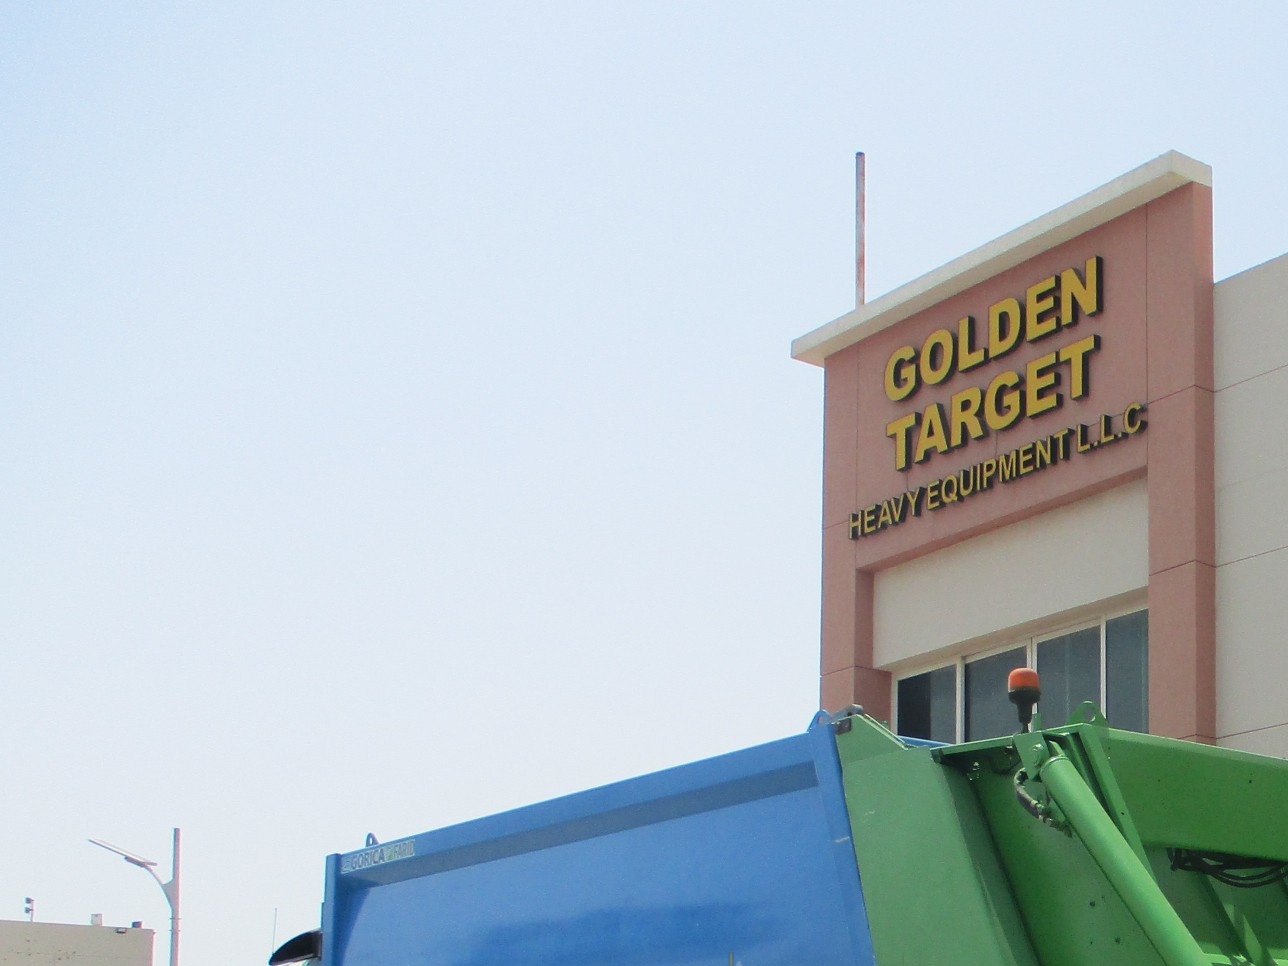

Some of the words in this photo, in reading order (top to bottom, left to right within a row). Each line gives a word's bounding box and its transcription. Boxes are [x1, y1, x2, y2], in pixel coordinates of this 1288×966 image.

[884, 256, 1102, 401] GOLDEN
[848, 486, 925, 540] HEAVY
[926, 428, 1074, 512] EQUIPMENT
[1076, 402, 1147, 453] L.L.C
[886, 334, 1100, 471] TARGET
[351, 848, 385, 870] GORICA
